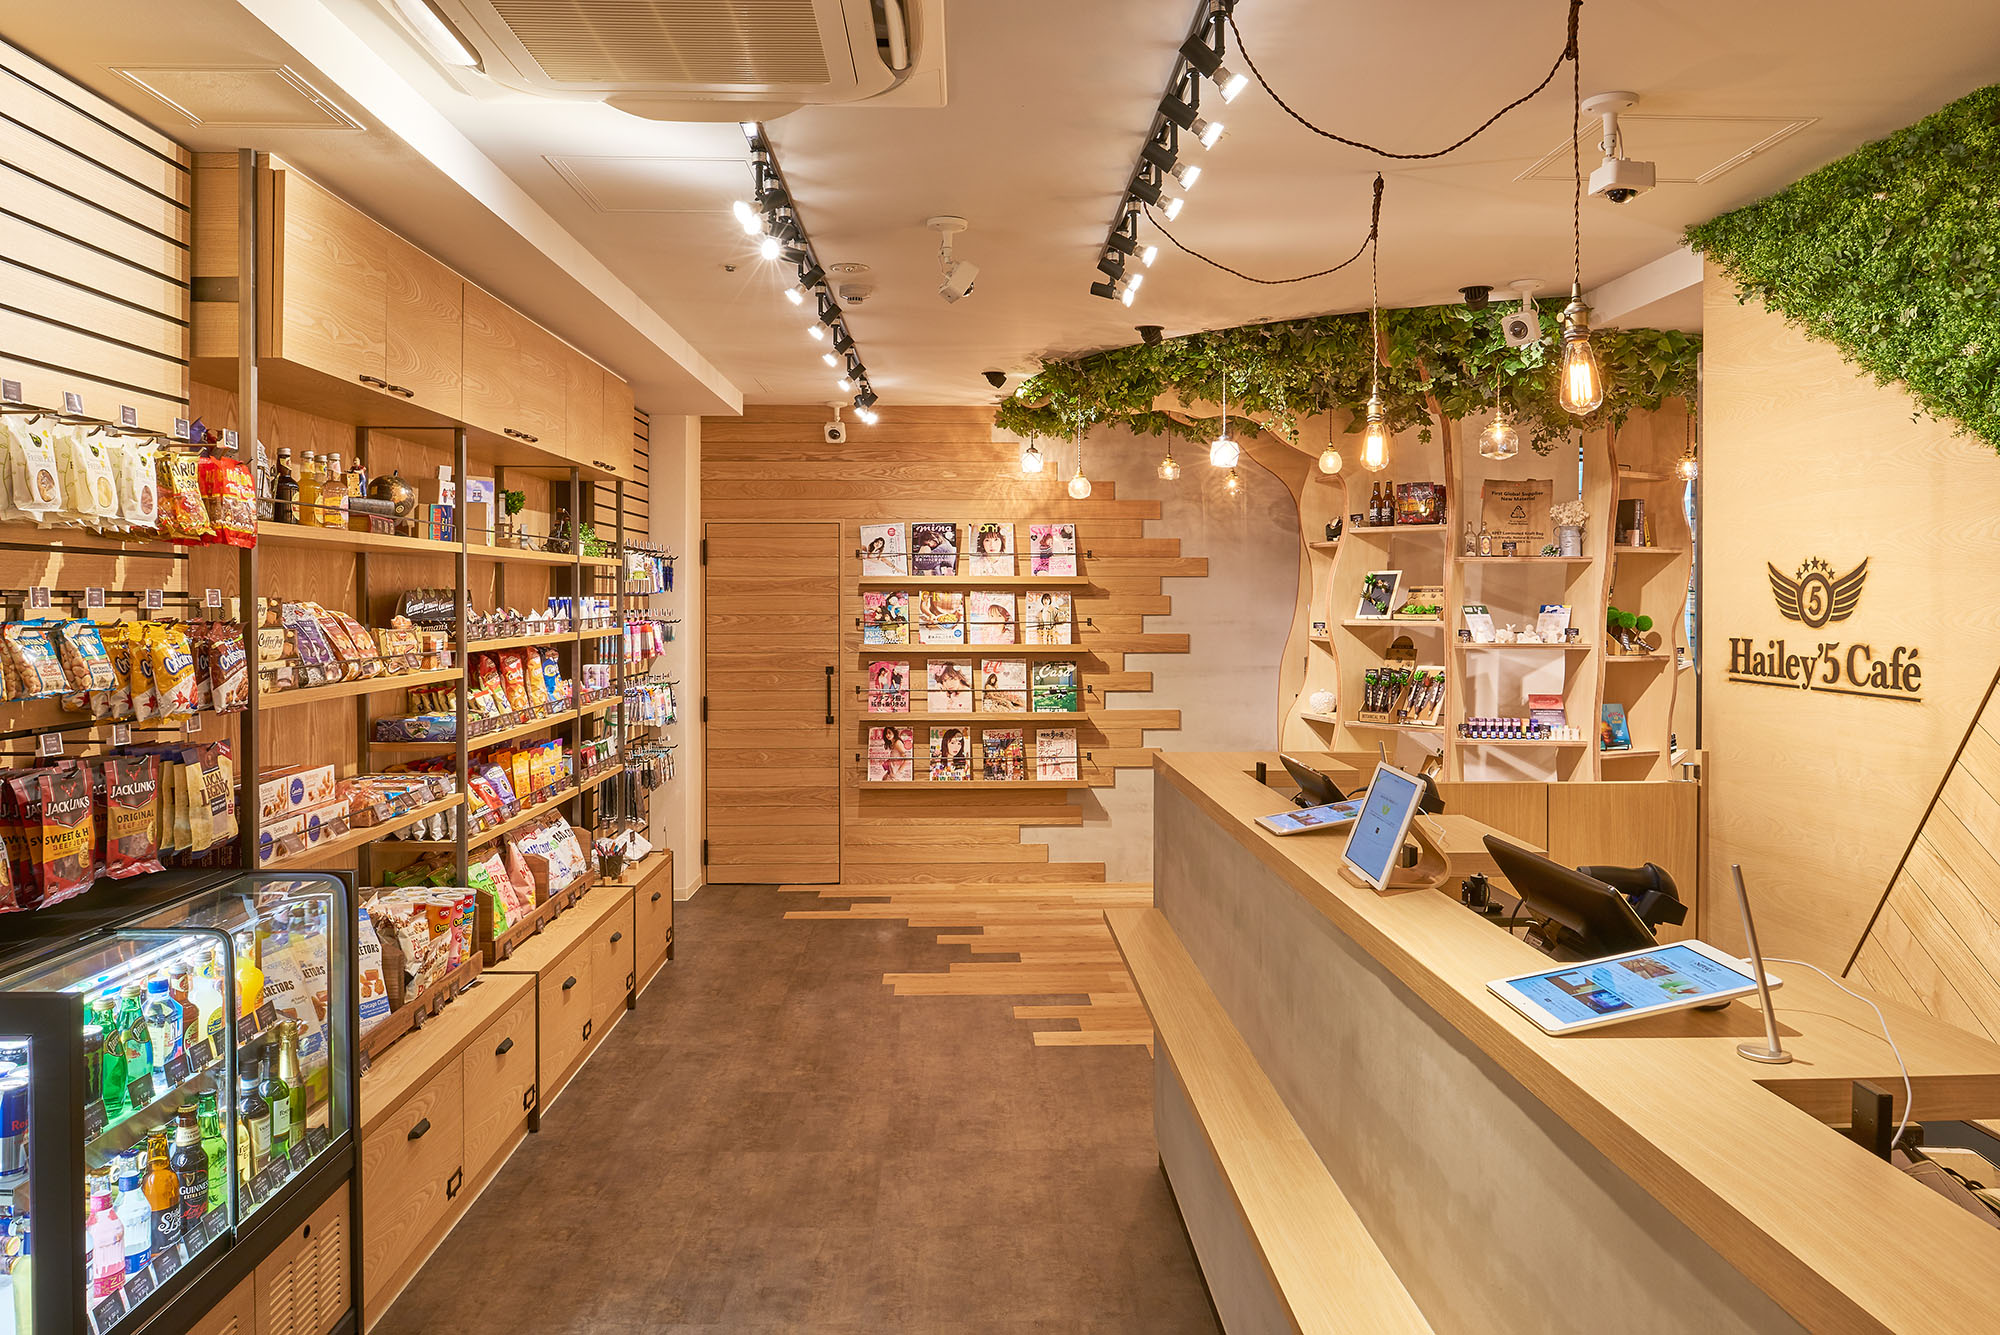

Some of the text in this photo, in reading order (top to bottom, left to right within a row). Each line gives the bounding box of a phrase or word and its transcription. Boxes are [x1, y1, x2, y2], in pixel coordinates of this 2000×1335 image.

[916, 524, 952, 532] mina
[1808, 586, 1822, 616] 5
[1039, 663, 1072, 678] Casa
[1846, 644, 1922, 692] Café
[203, 772, 222, 787] LOCAL
[110, 784, 135, 798] JACK
[200, 780, 230, 807] LEGENDS
[25, 802, 42, 819] JAC
[45, 796, 90, 817] JACK LINK'S
[117, 810, 155, 823] ORIGINAL
[45, 831, 74, 845] SWEET
[53, 842, 72, 851] BEEF
[359, 944, 380, 955] ETORS
[180, 1182, 208, 1195] GUINNES
